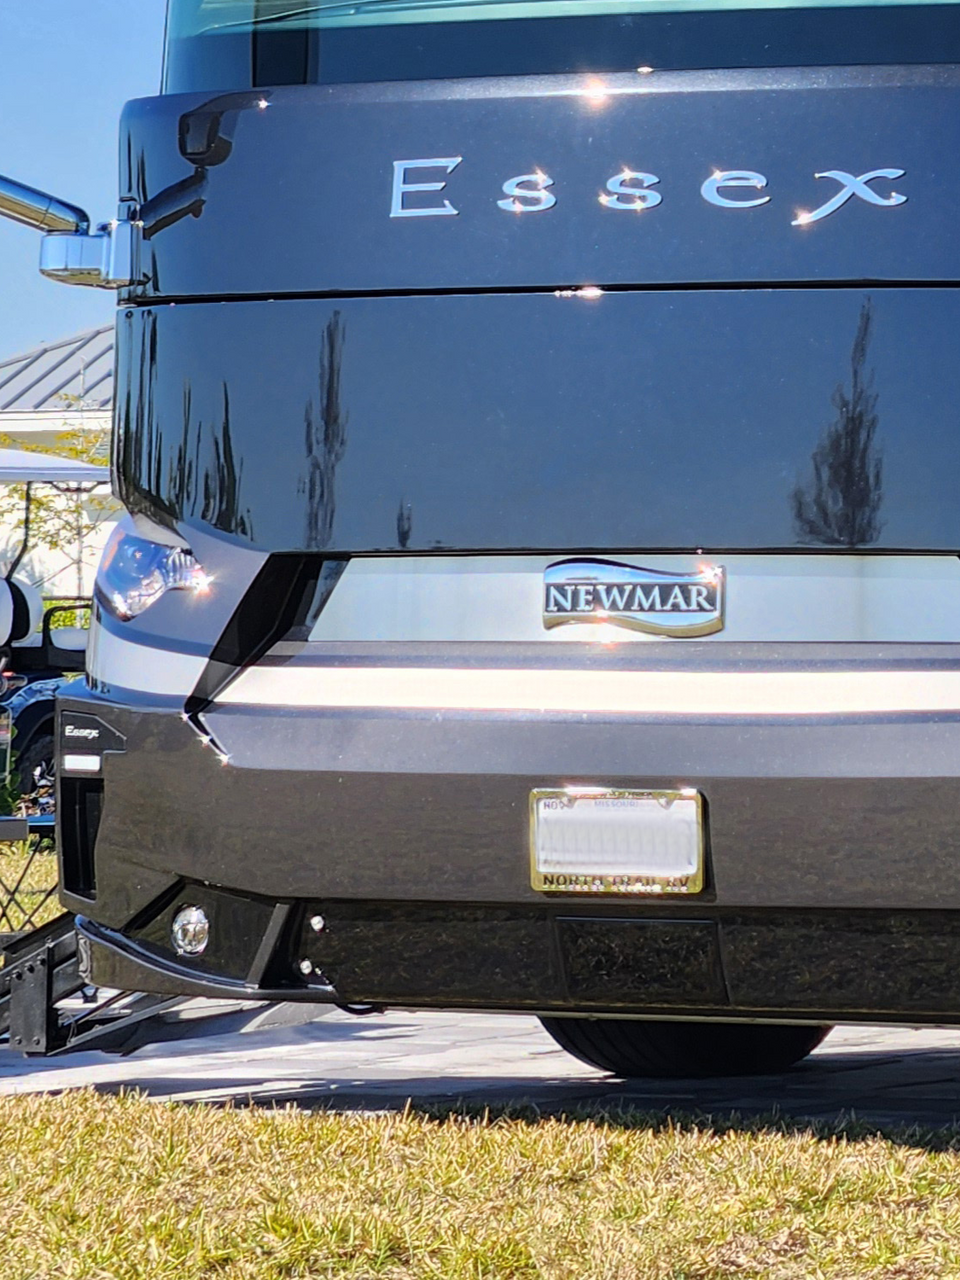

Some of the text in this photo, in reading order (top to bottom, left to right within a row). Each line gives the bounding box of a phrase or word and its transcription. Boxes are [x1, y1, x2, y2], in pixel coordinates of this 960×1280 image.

[389, 156, 908, 226] Essex
[547, 585, 714, 612] NEWMAR
[543, 874, 603, 886] NORTH
